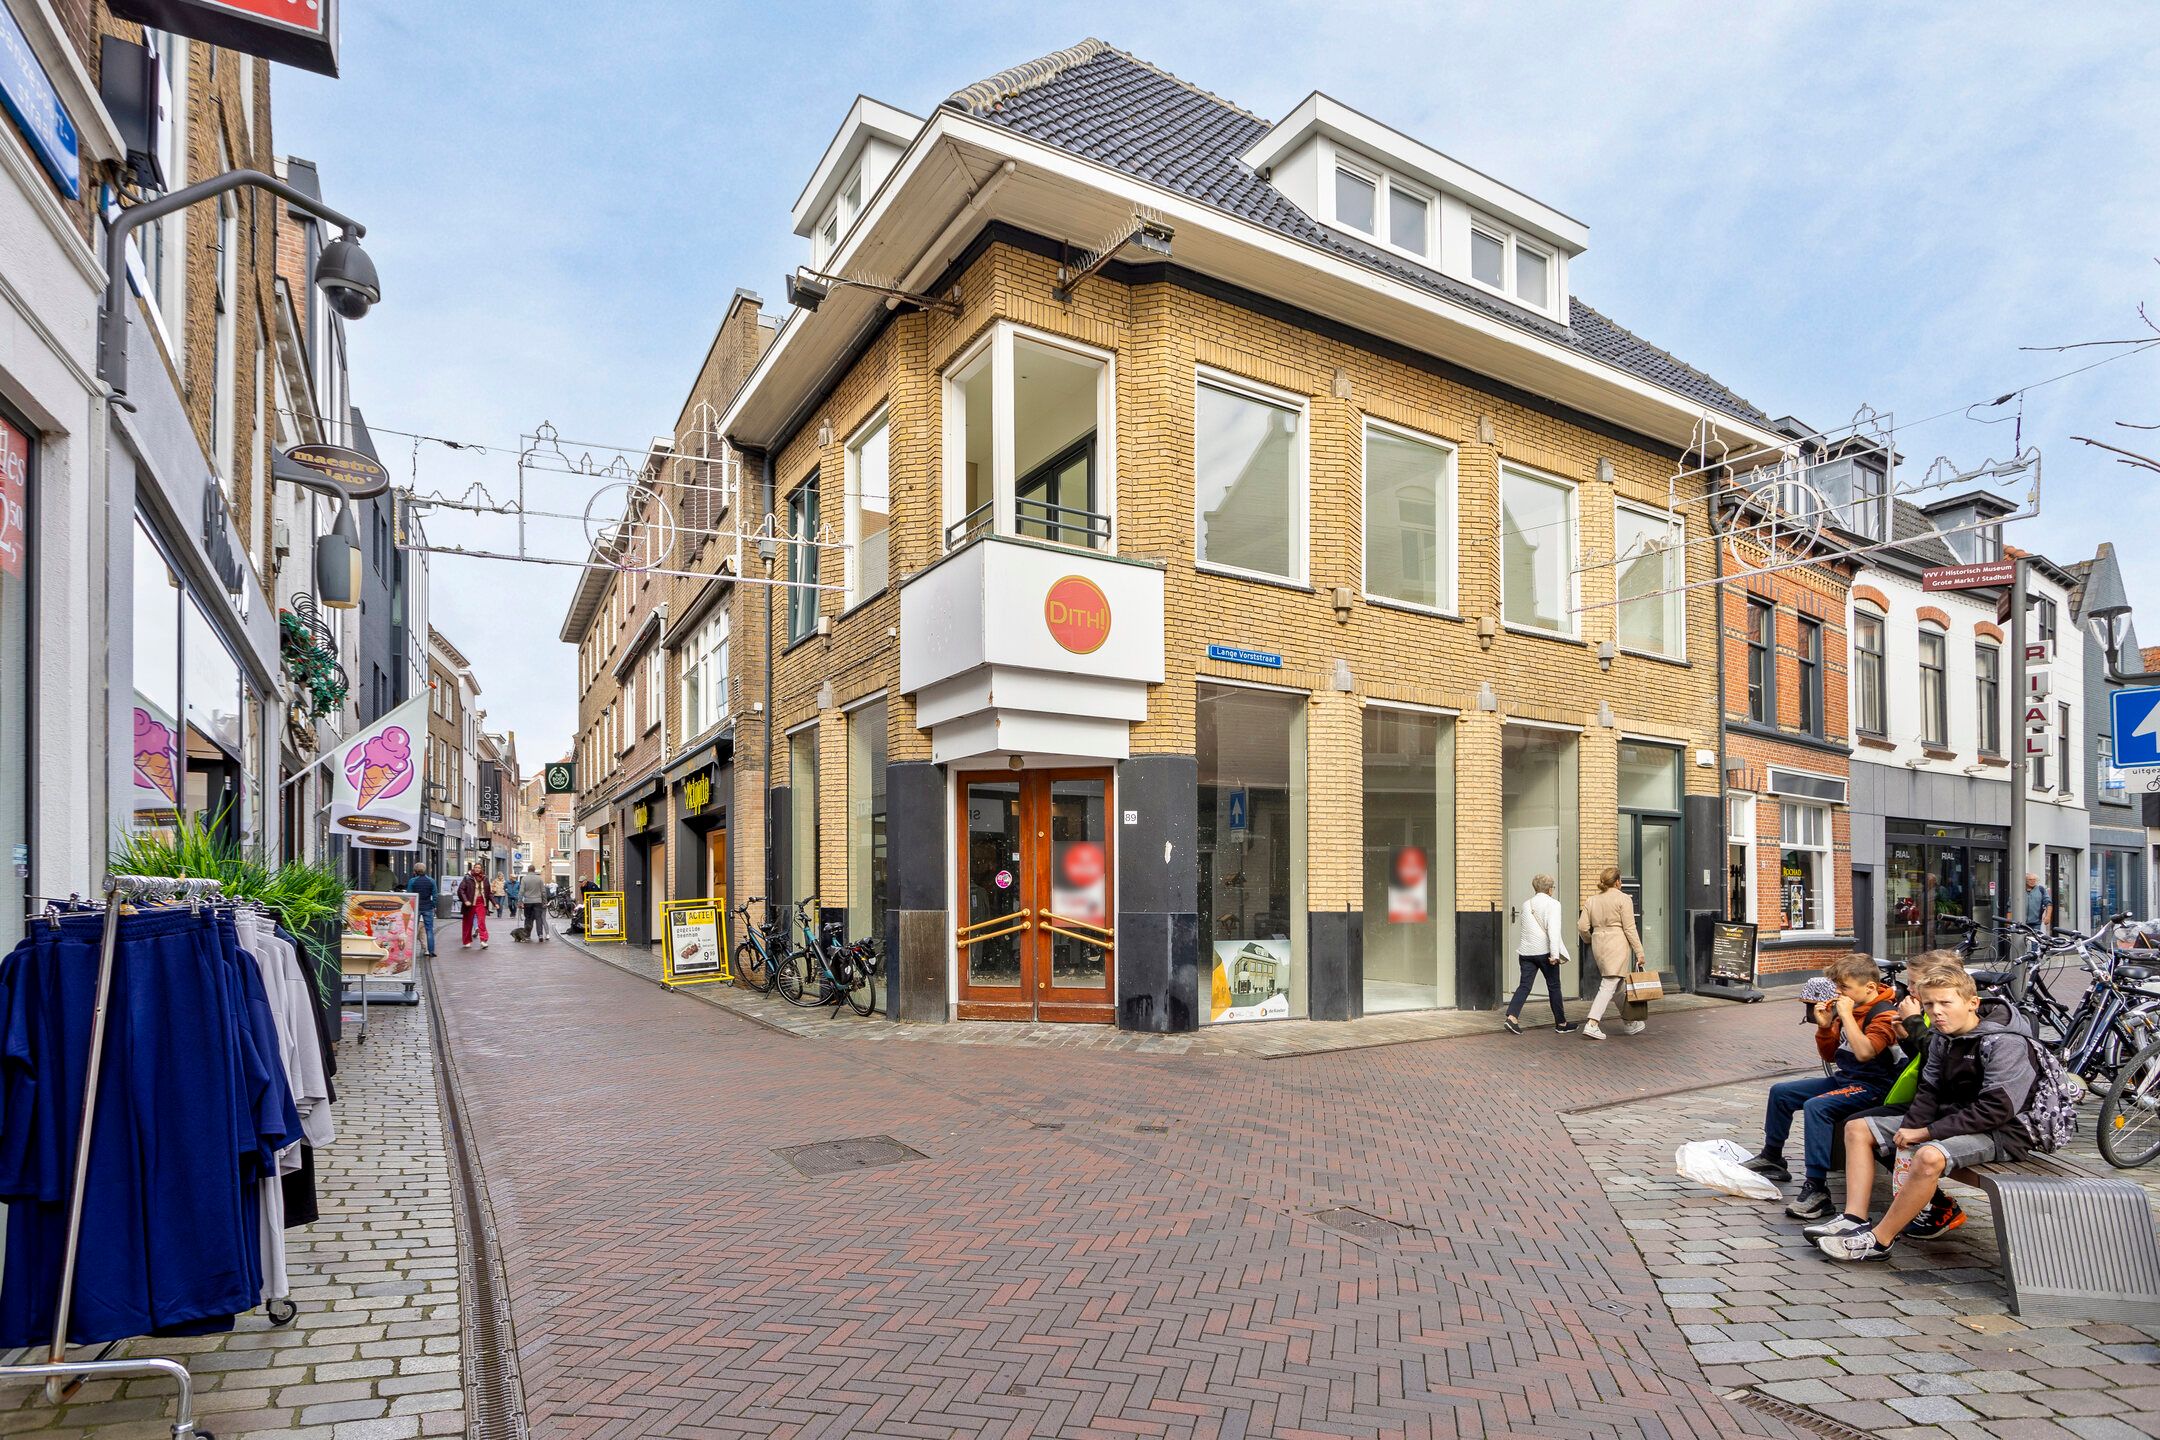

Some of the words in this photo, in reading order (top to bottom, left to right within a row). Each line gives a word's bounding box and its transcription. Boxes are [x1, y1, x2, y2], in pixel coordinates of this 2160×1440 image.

[293, 451, 379, 474] maestro
[325, 467, 366, 486] lato
[1945, 567, 1981, 576] Historisch
[1982, 565, 2012, 573] Museum
[1953, 577, 1975, 585] Markt
[1981, 573, 2013, 582] Stadhuis
[1216, 647, 1238, 658] Lange
[1239, 650, 1276, 664] Vorststraat
[2025, 645, 2047, 754] RIAL
[1124, 813, 1137, 822] 89
[1895, 850, 1910, 859] RIAL
[1941, 852, 1955, 860] RIAL
[1978, 854, 1991, 862] RIAL
[688, 910, 714, 919] ACTIE!
